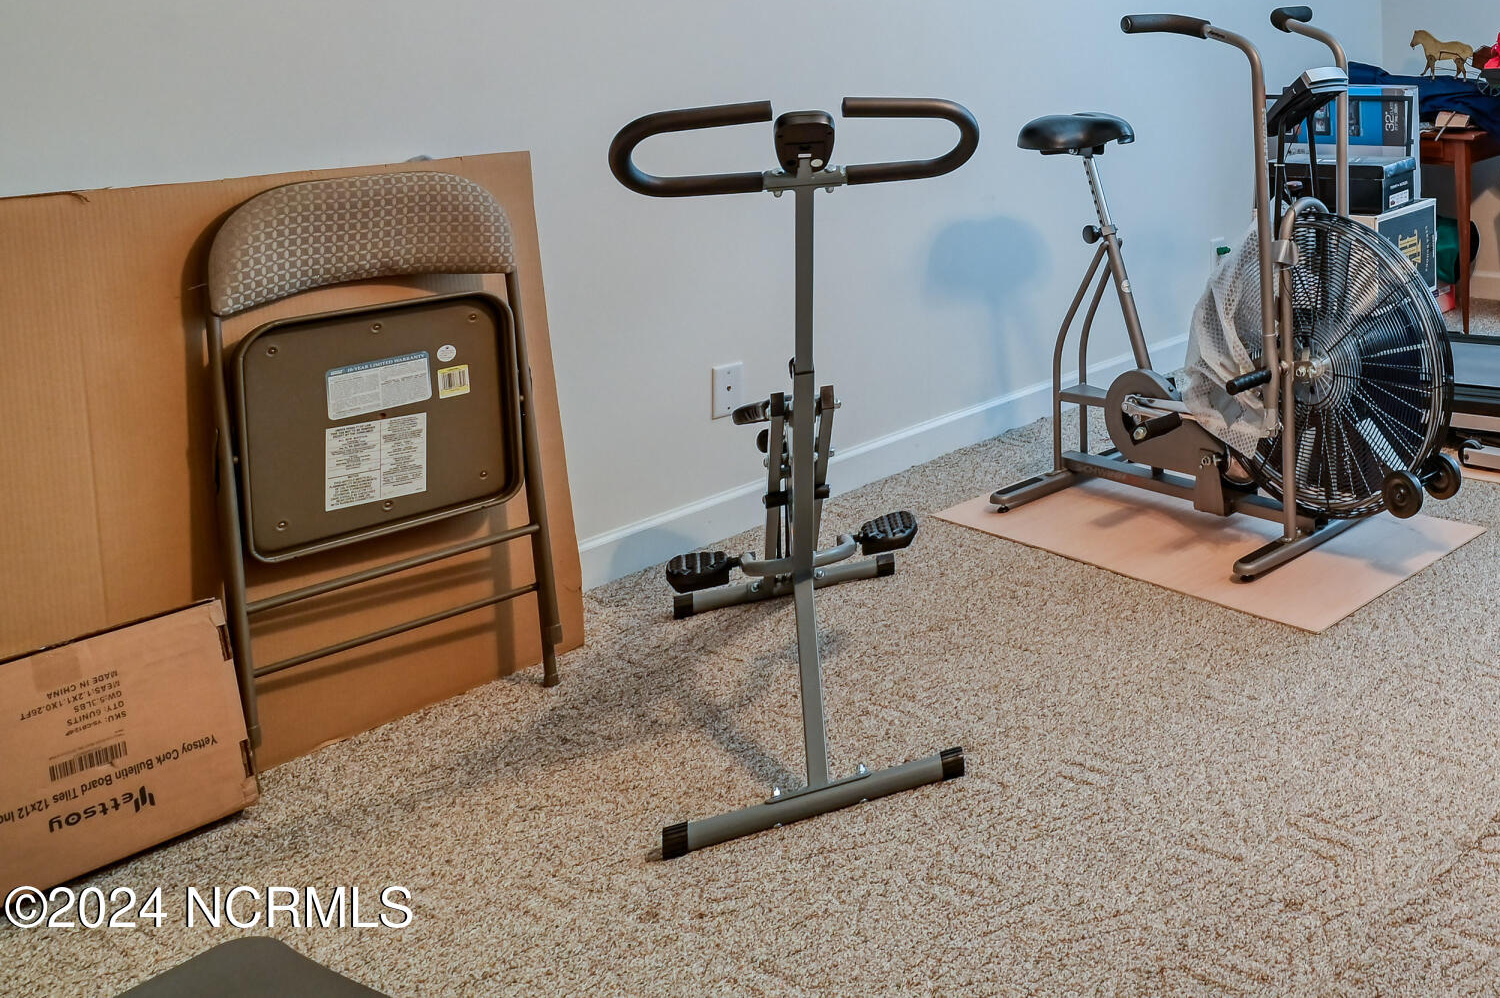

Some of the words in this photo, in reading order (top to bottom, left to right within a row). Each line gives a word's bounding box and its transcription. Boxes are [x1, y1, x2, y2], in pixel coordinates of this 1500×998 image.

[80, 680, 90, 689] IN
[92, 670, 118, 684] MADE
[46, 684, 77, 700] CHINA
[181, 734, 218, 755] Yettsoy
[156, 751, 180, 766] Cork
[115, 758, 154, 781] Bulletin
[81, 774, 113, 796] Board
[52, 786, 79, 804] Tiles
[17, 801, 50, 820] 12x12
